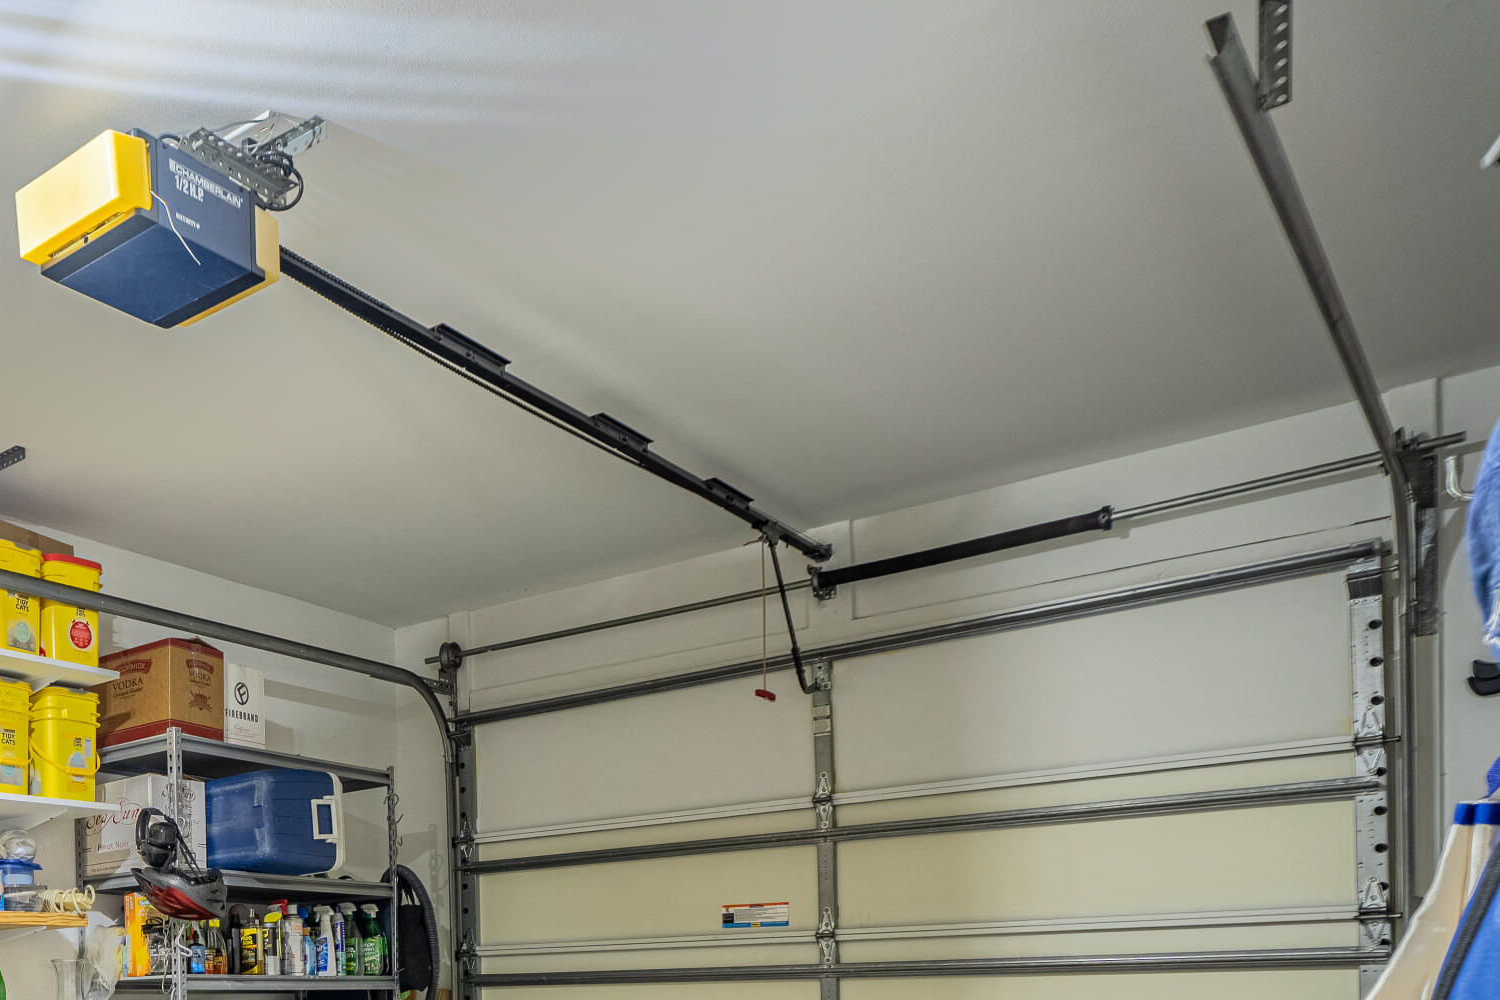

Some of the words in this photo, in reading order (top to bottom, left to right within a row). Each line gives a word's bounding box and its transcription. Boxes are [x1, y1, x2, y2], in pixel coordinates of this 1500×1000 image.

[175, 174, 189, 195] 1/2
[175, 163, 241, 209] CHAMBERLAIN
[15, 603, 30, 612] CATS
[16, 597, 29, 606] TIDY
[112, 677, 144, 691] VODKA
[225, 708, 259, 723] FIREBRAND
[97, 843, 113, 852] Pinot
